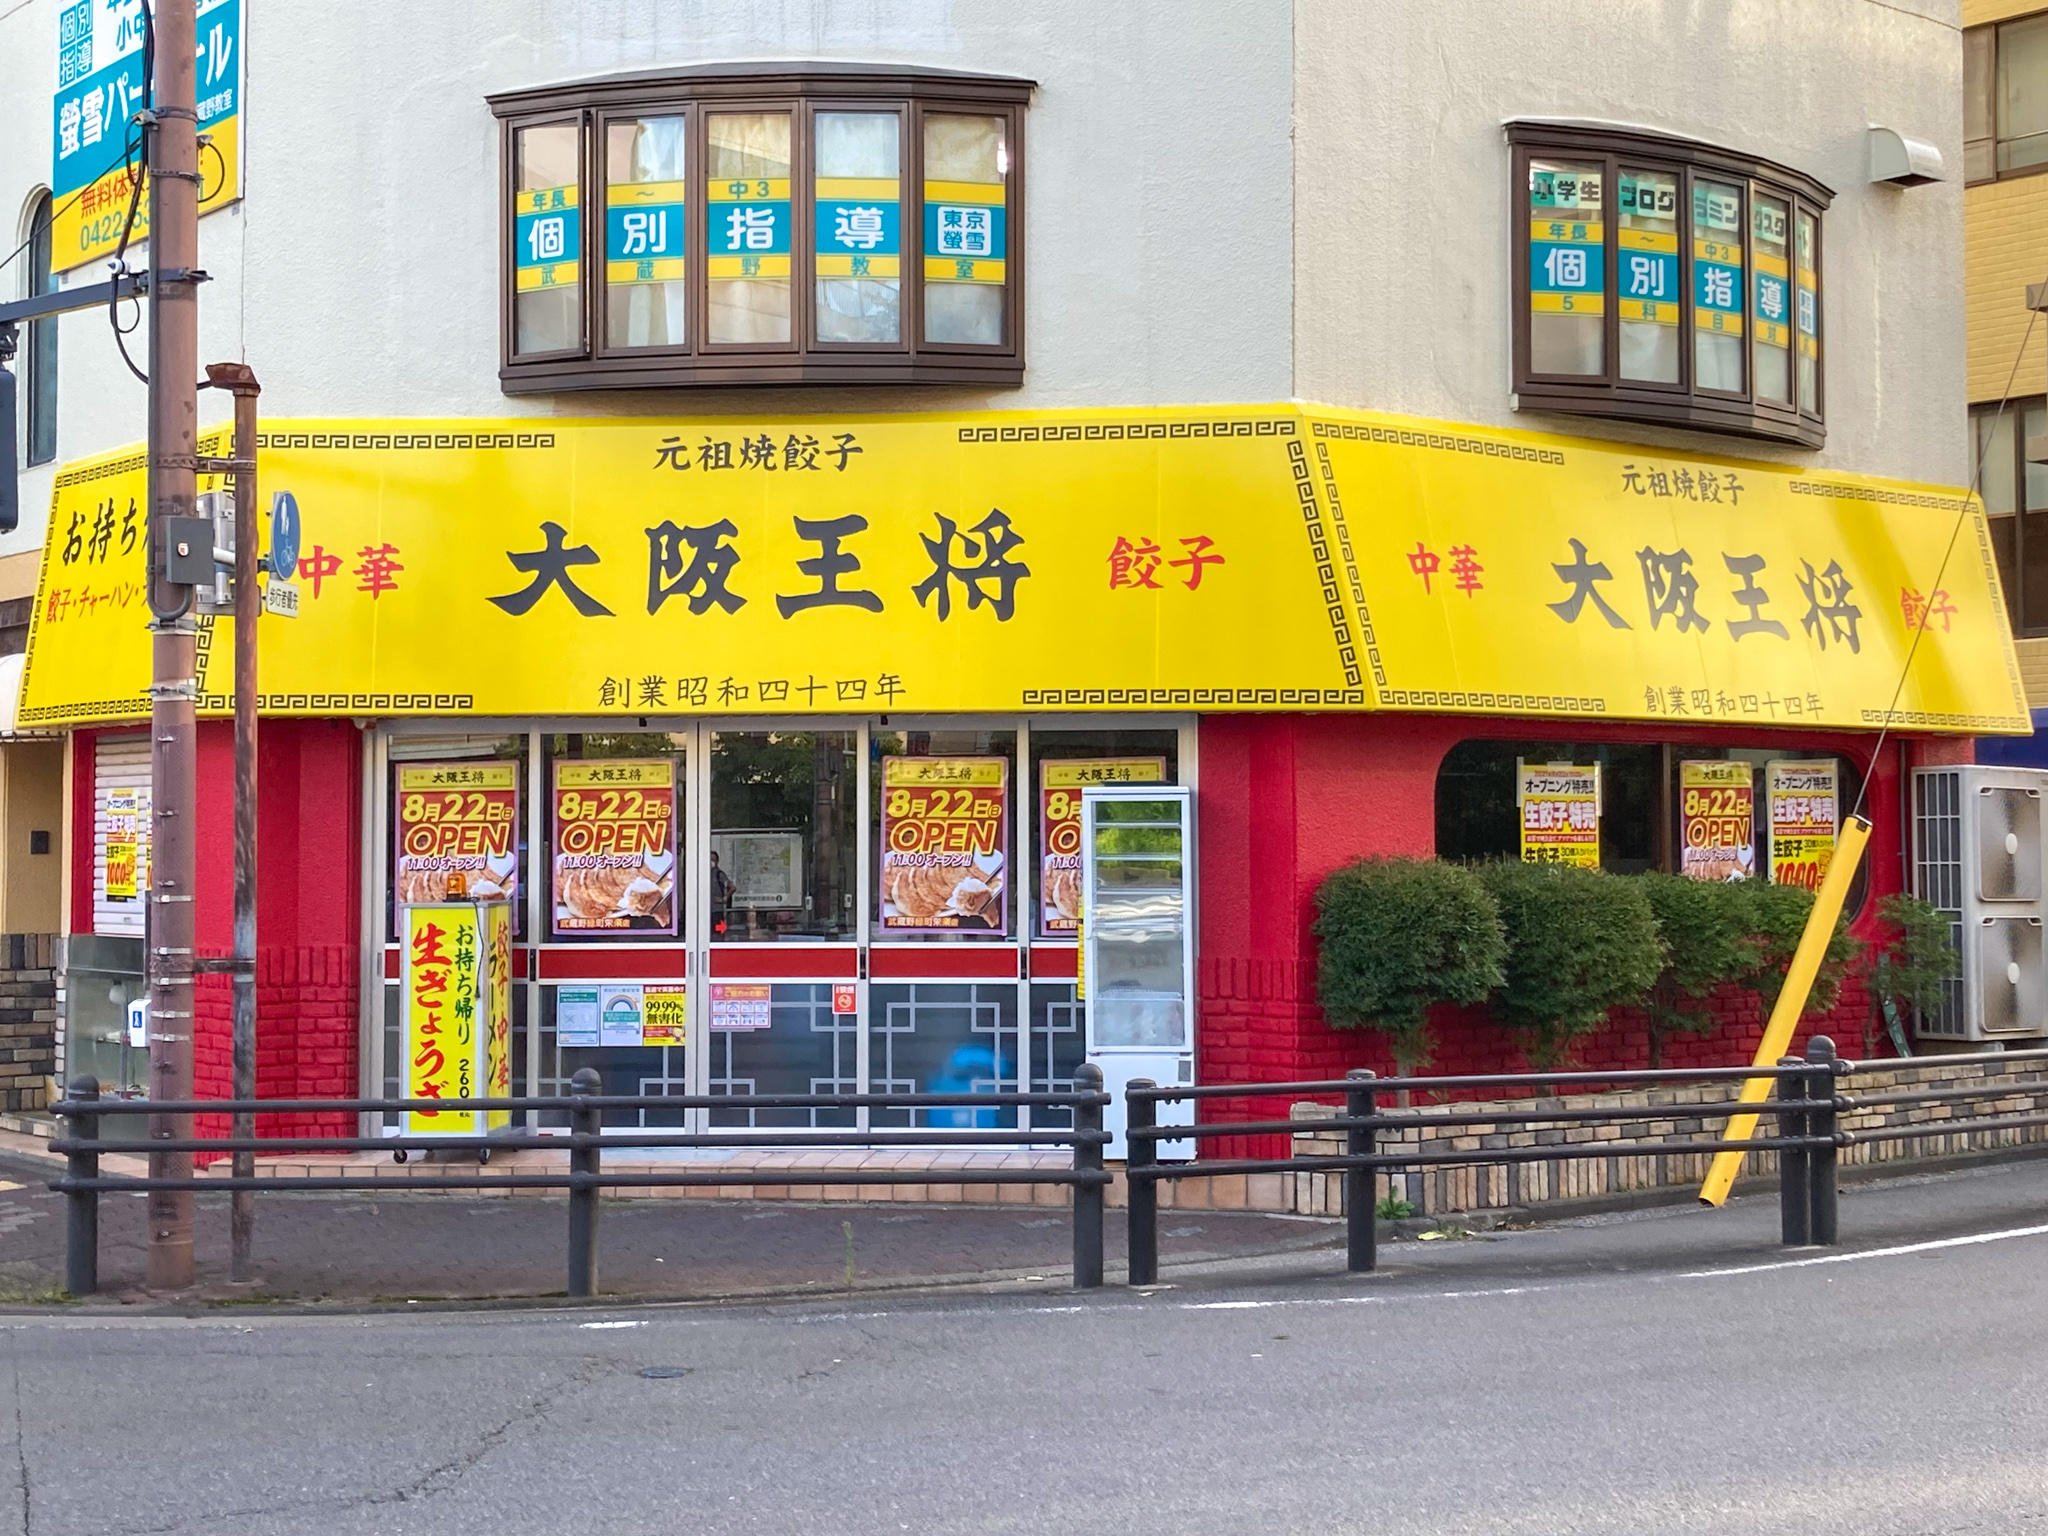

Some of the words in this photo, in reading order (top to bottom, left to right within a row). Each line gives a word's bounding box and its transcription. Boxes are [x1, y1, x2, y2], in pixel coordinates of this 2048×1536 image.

[61, 3, 93, 46] 個別
[60, 40, 93, 84] 指導
[652, 432, 863, 473] 元祖焼餃子
[1621, 464, 1745, 506] 元祖焼餃子
[297, 542, 405, 600] 中華
[485, 508, 1031, 622] 大阪王将
[1105, 535, 1226, 591] 餃子
[269, 586, 299, 611] 歩行者優先
[1406, 541, 1484, 599] 中華
[1545, 537, 1863, 654] 大阪王将
[1900, 586, 1958, 634] 餃子
[597, 673, 907, 708] 創業昭和四十四年
[1643, 684, 1825, 722] 創業昭和四十四年
[432, 770, 485, 784] 大阪王将
[588, 769, 642, 782] 大阪王将
[918, 766, 972, 780] 大阪王将
[1075, 768, 1132, 782] 大阪王将
[1524, 800, 1596, 831] 生餃子特売
[1772, 795, 1834, 825] 生餃子特売
[405, 822, 511, 858] OPEN
[561, 820, 668, 857] OPEN
[890, 818, 999, 856] OPEN
[1686, 816, 1750, 849] OPEN
[1773, 839, 1803, 858] 生餃子
[406, 856, 439, 871] 11:00
[563, 855, 596, 869] 11:00
[892, 853, 925, 867] 11:00
[454, 923, 475, 1046] お持ち帰り
[411, 922, 453, 1118] 生ぎょうざ
